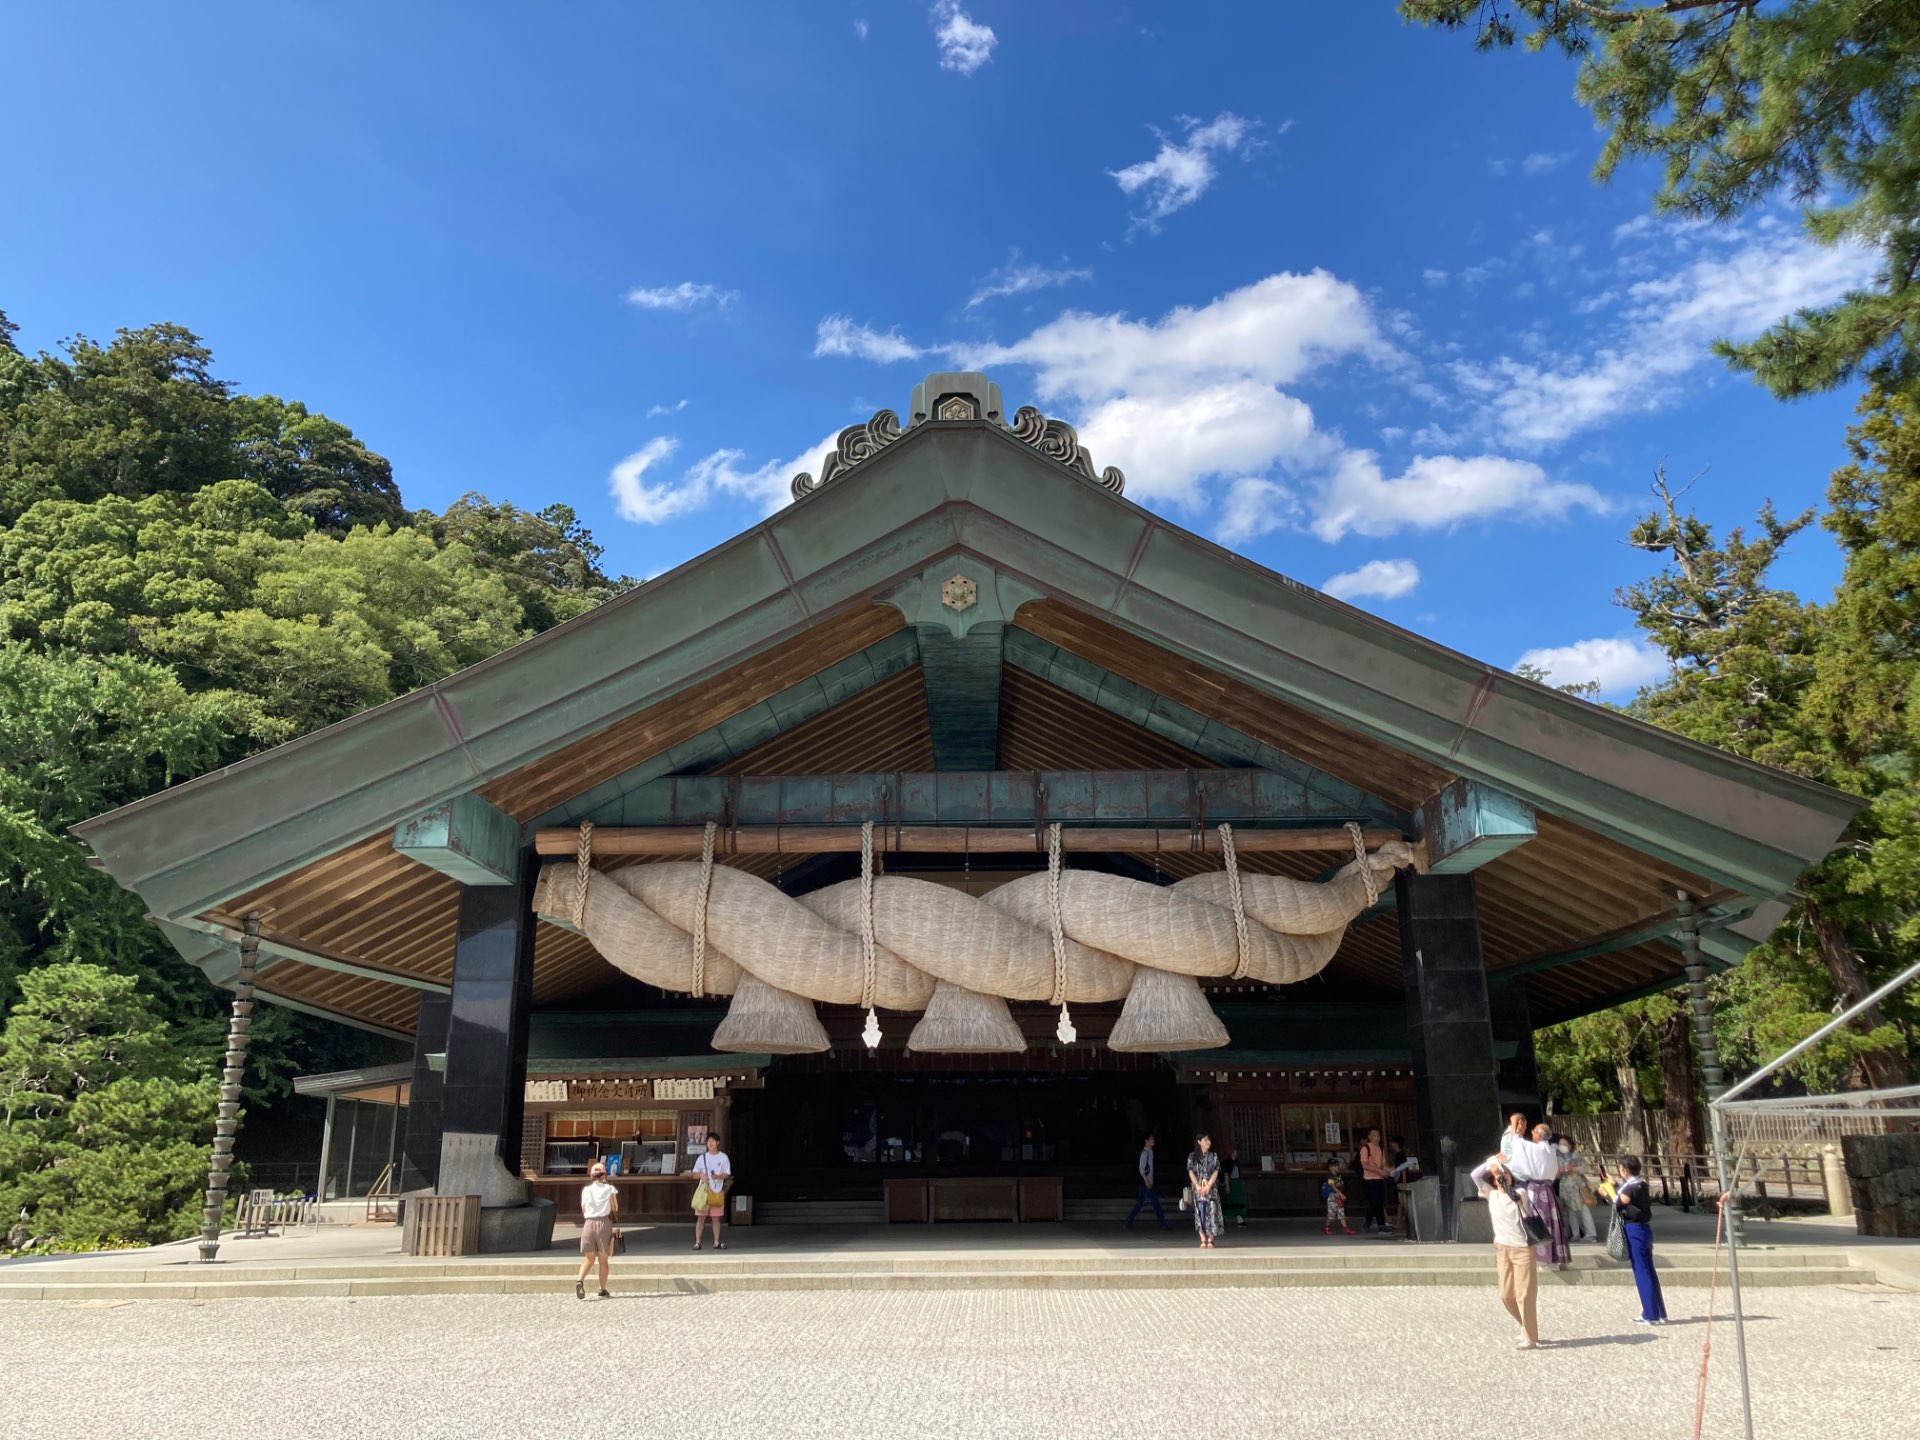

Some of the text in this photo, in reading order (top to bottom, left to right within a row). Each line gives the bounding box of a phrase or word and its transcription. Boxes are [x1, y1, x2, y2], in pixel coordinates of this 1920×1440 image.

[572, 1084, 648, 1098] 御祈念受付所
[1298, 1074, 1367, 1093] 御守所
